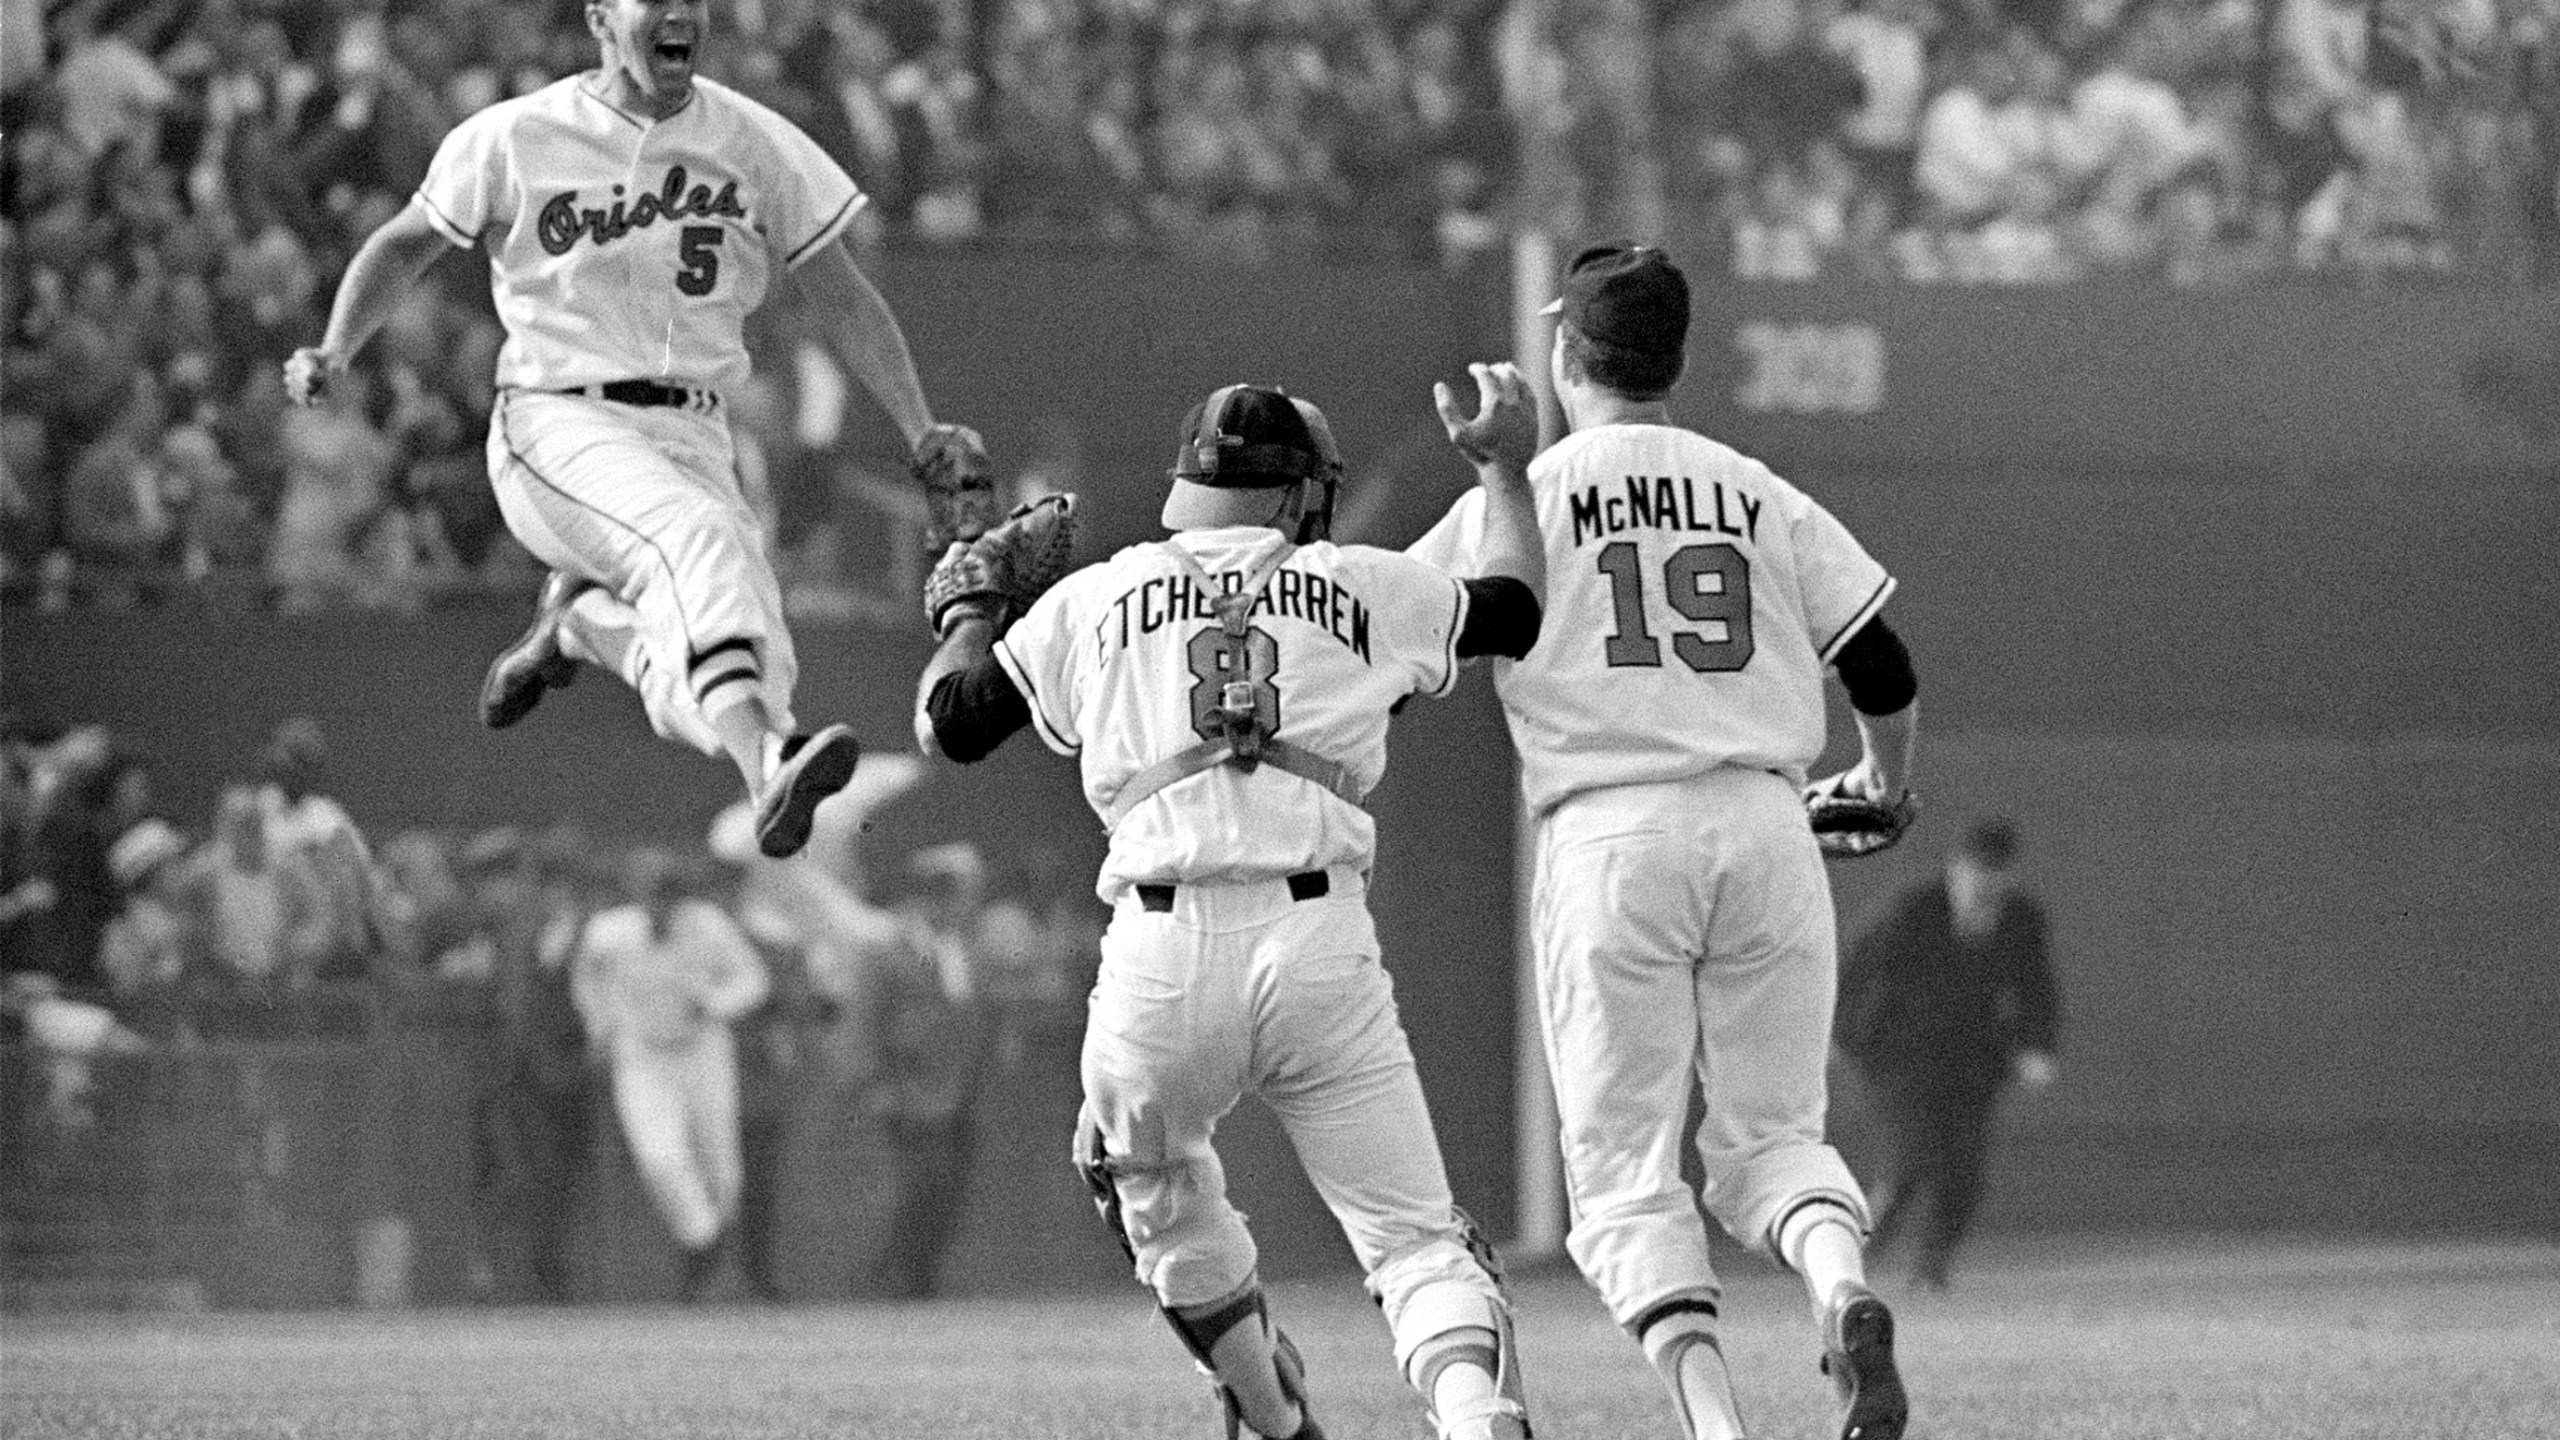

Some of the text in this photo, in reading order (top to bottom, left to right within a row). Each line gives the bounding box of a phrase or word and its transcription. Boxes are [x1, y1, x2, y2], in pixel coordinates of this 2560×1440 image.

[538, 165, 746, 255] Orioles
[676, 227, 723, 296] 5
[1570, 475, 1761, 547] McNALLY
[1597, 542, 1755, 673] 19
[1187, 627, 1280, 741] 8
